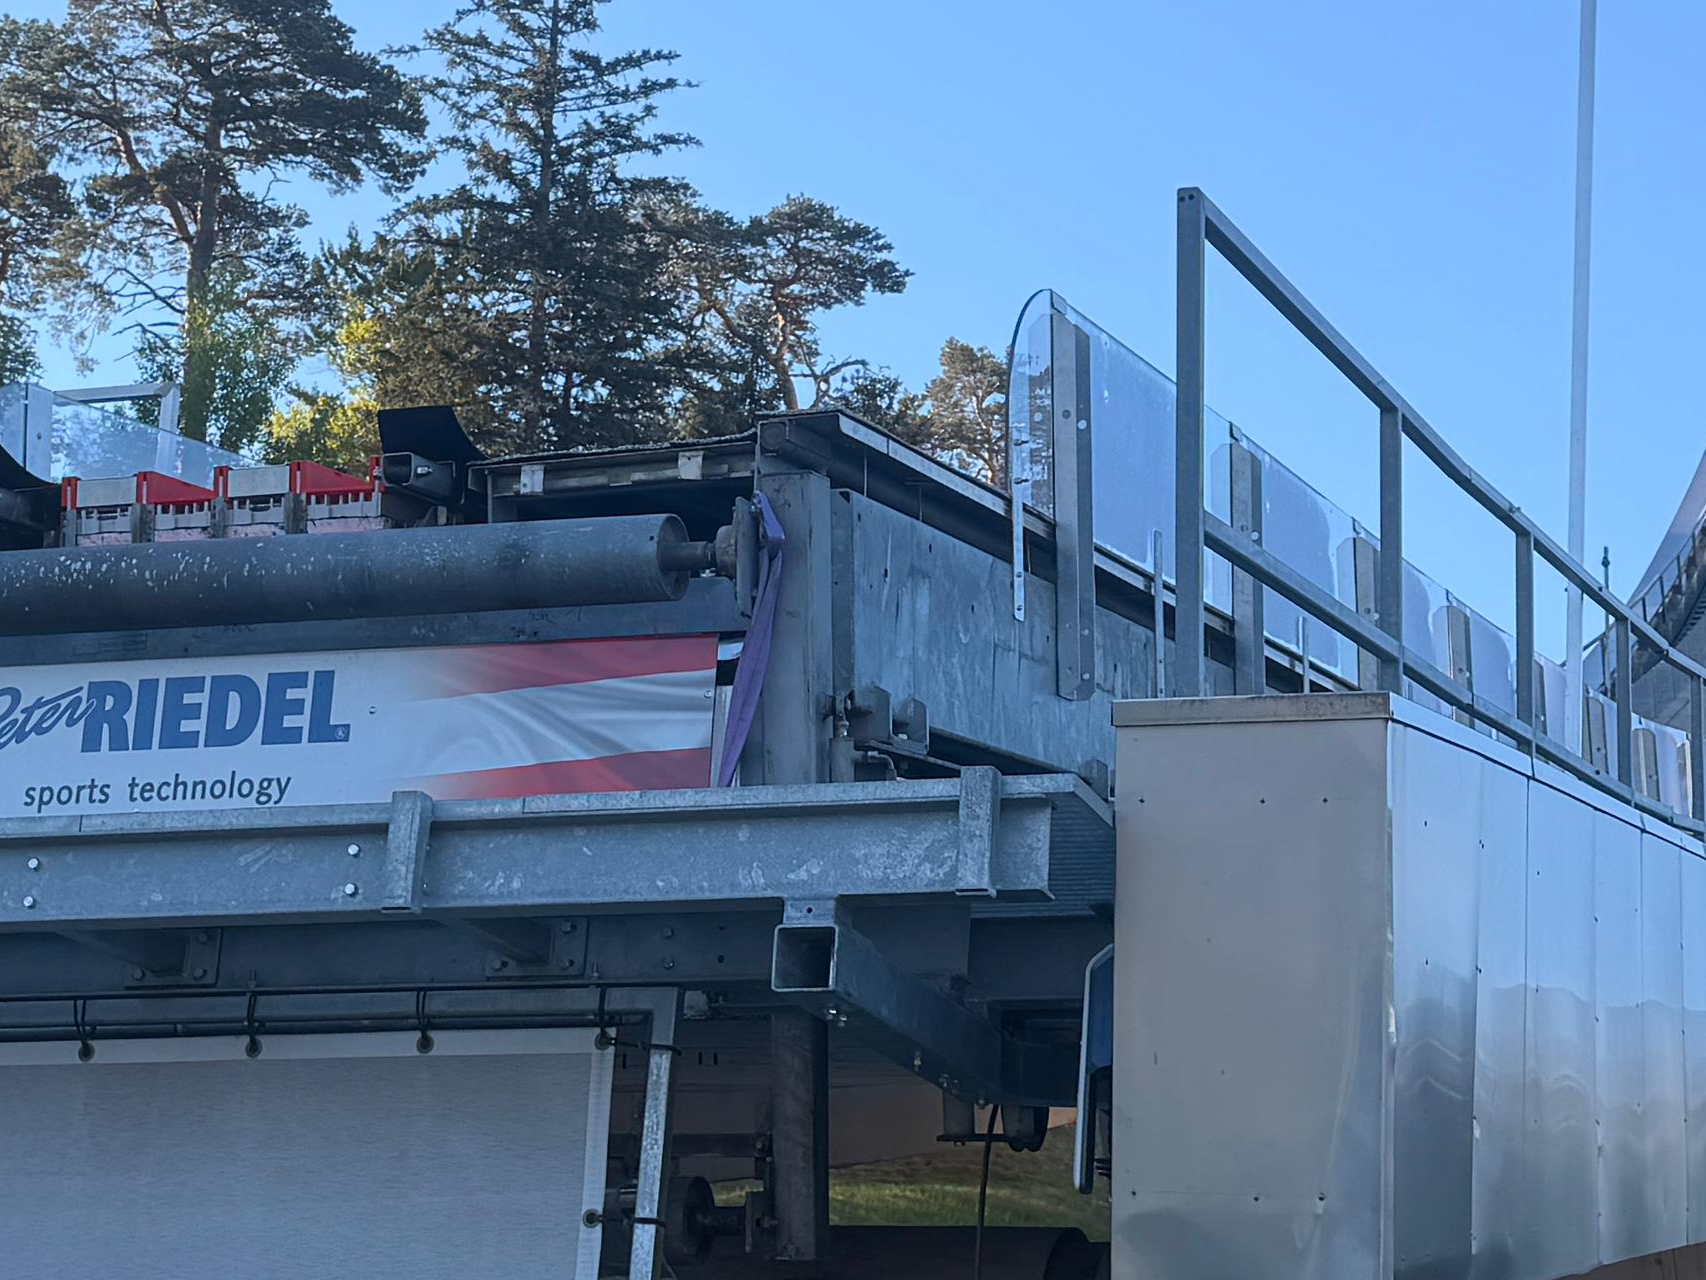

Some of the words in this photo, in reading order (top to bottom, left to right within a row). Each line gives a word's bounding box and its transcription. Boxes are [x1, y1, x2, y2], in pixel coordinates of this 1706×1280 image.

[81, 670, 351, 753] RIEDEL
[23, 778, 111, 814] sports
[128, 770, 292, 806] technology
